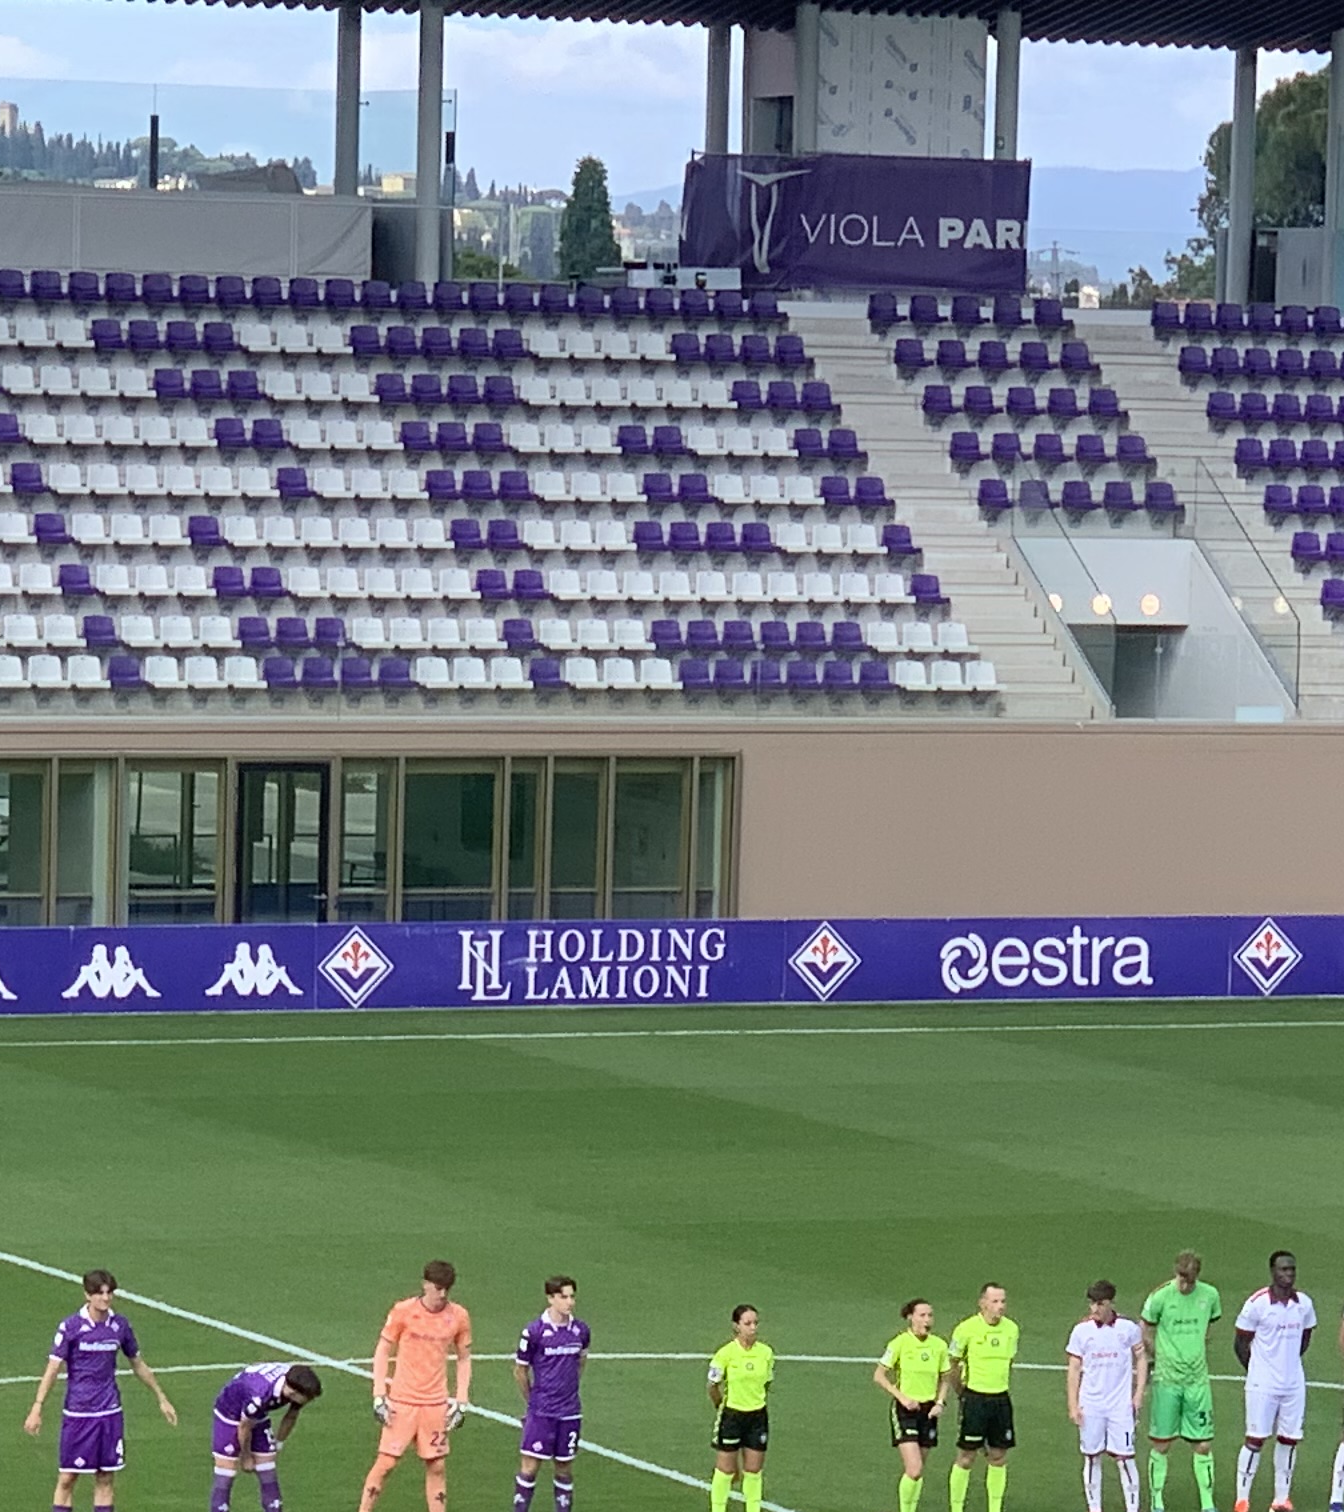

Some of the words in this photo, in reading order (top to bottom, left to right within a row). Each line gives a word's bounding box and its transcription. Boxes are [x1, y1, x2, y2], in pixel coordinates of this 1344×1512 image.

[800, 213, 925, 248] VIOLA
[939, 217, 1027, 250] PAR
[526, 928, 726, 963] HOLDING
[991, 926, 1154, 987] estra
[524, 965, 710, 1000] LAMIONI
[430, 1430, 447, 1447] 22
[567, 1431, 577, 1448] 2
